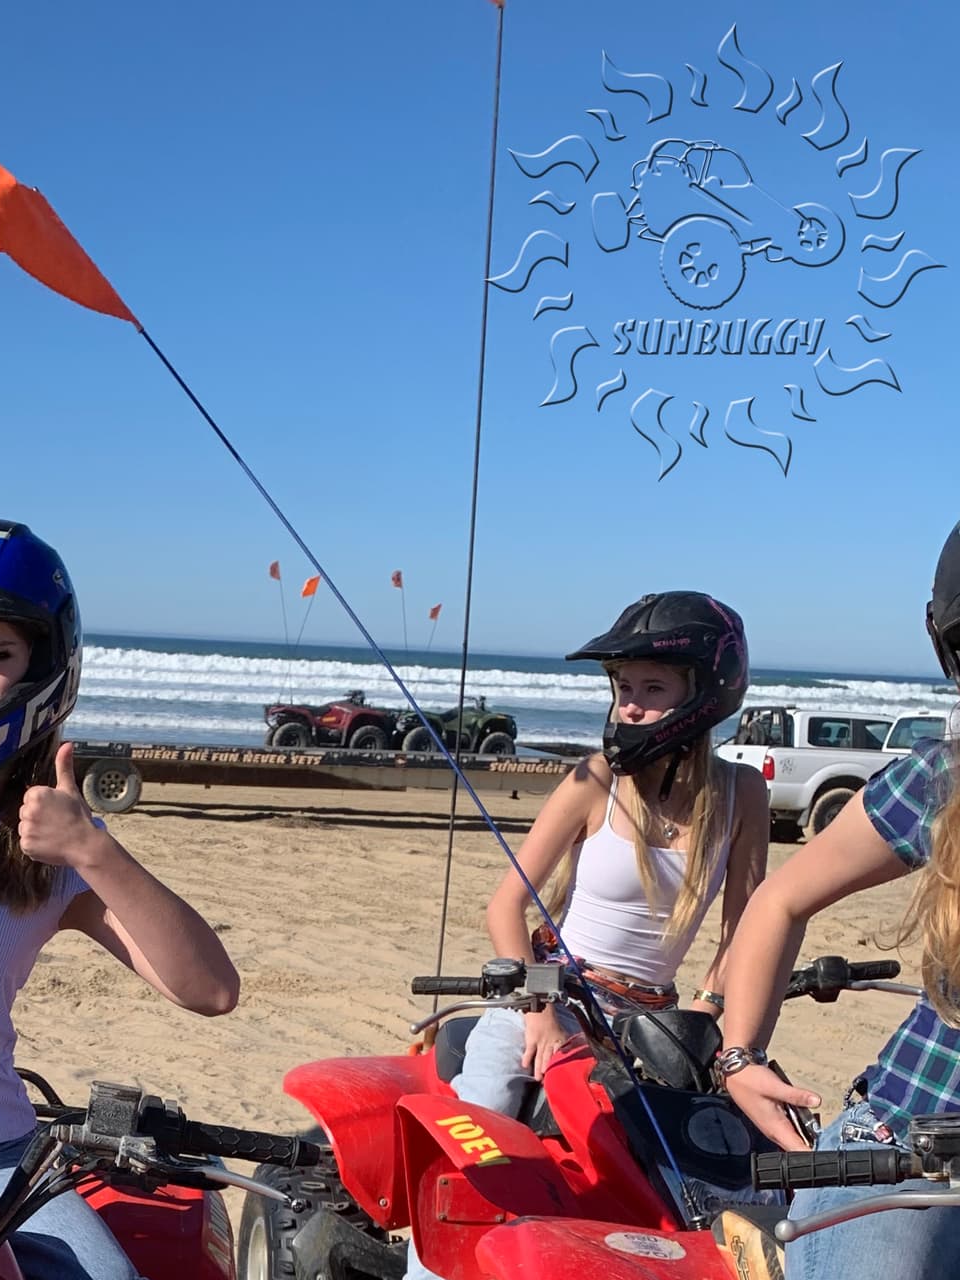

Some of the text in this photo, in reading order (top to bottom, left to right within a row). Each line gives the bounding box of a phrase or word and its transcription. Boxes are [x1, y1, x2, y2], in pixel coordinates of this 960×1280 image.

[131, 749, 323, 766] WHERE THE FUN NEVER SETS
[435, 1114, 512, 1168] JOEY
